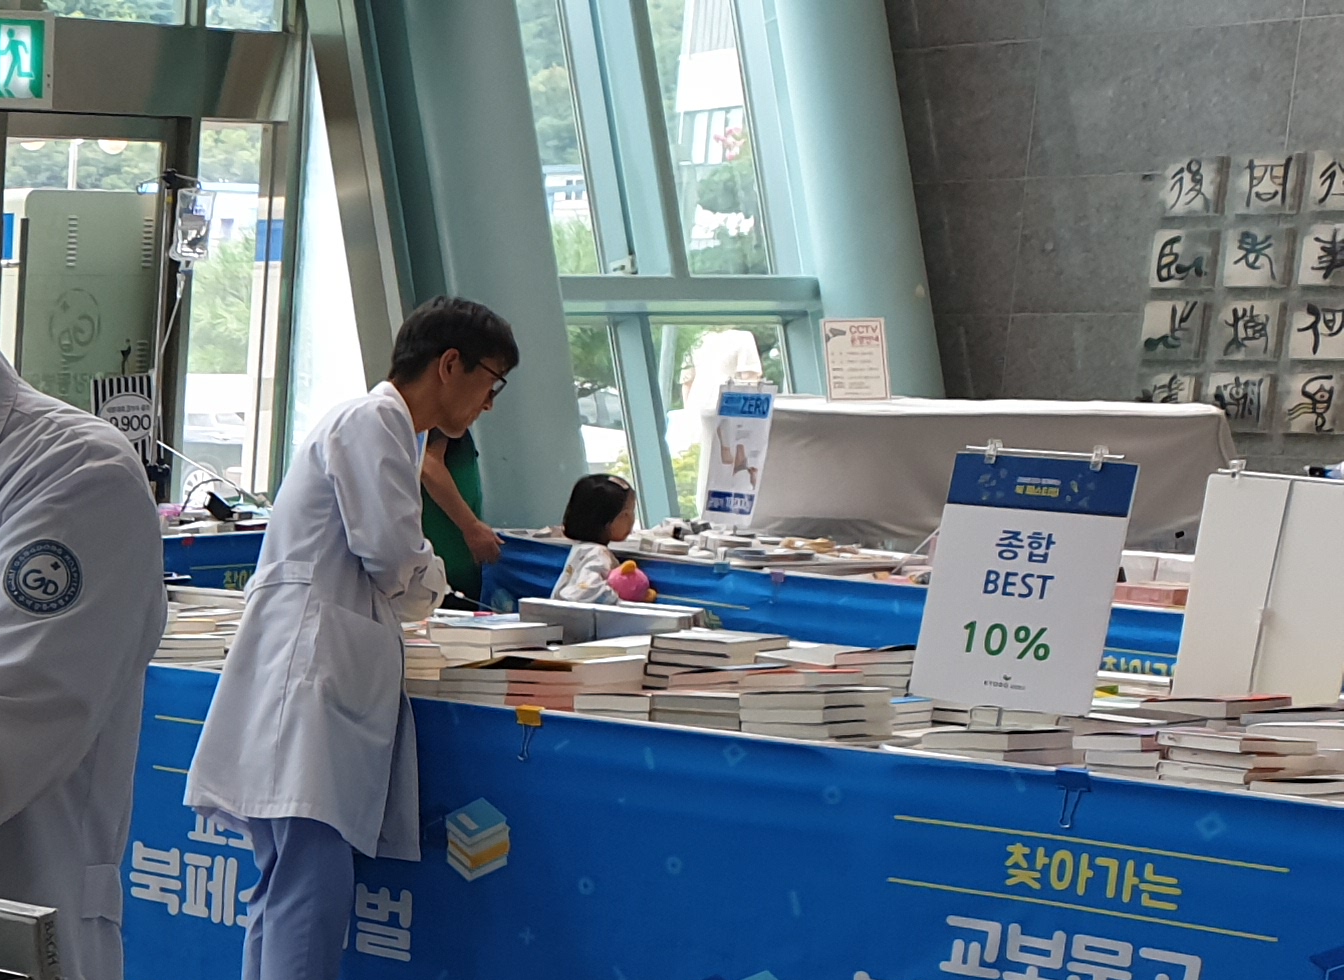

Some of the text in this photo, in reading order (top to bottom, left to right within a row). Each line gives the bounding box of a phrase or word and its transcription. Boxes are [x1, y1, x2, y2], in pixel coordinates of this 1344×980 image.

[849, 324, 878, 335] CCTV
[740, 393, 770, 415] ZERO
[995, 529, 1056, 564] 종합
[22, 569, 59, 596] GD
[982, 569, 1054, 600] BEST
[963, 620, 1051, 661] 10%
[1004, 842, 1182, 913] 찾아가는
